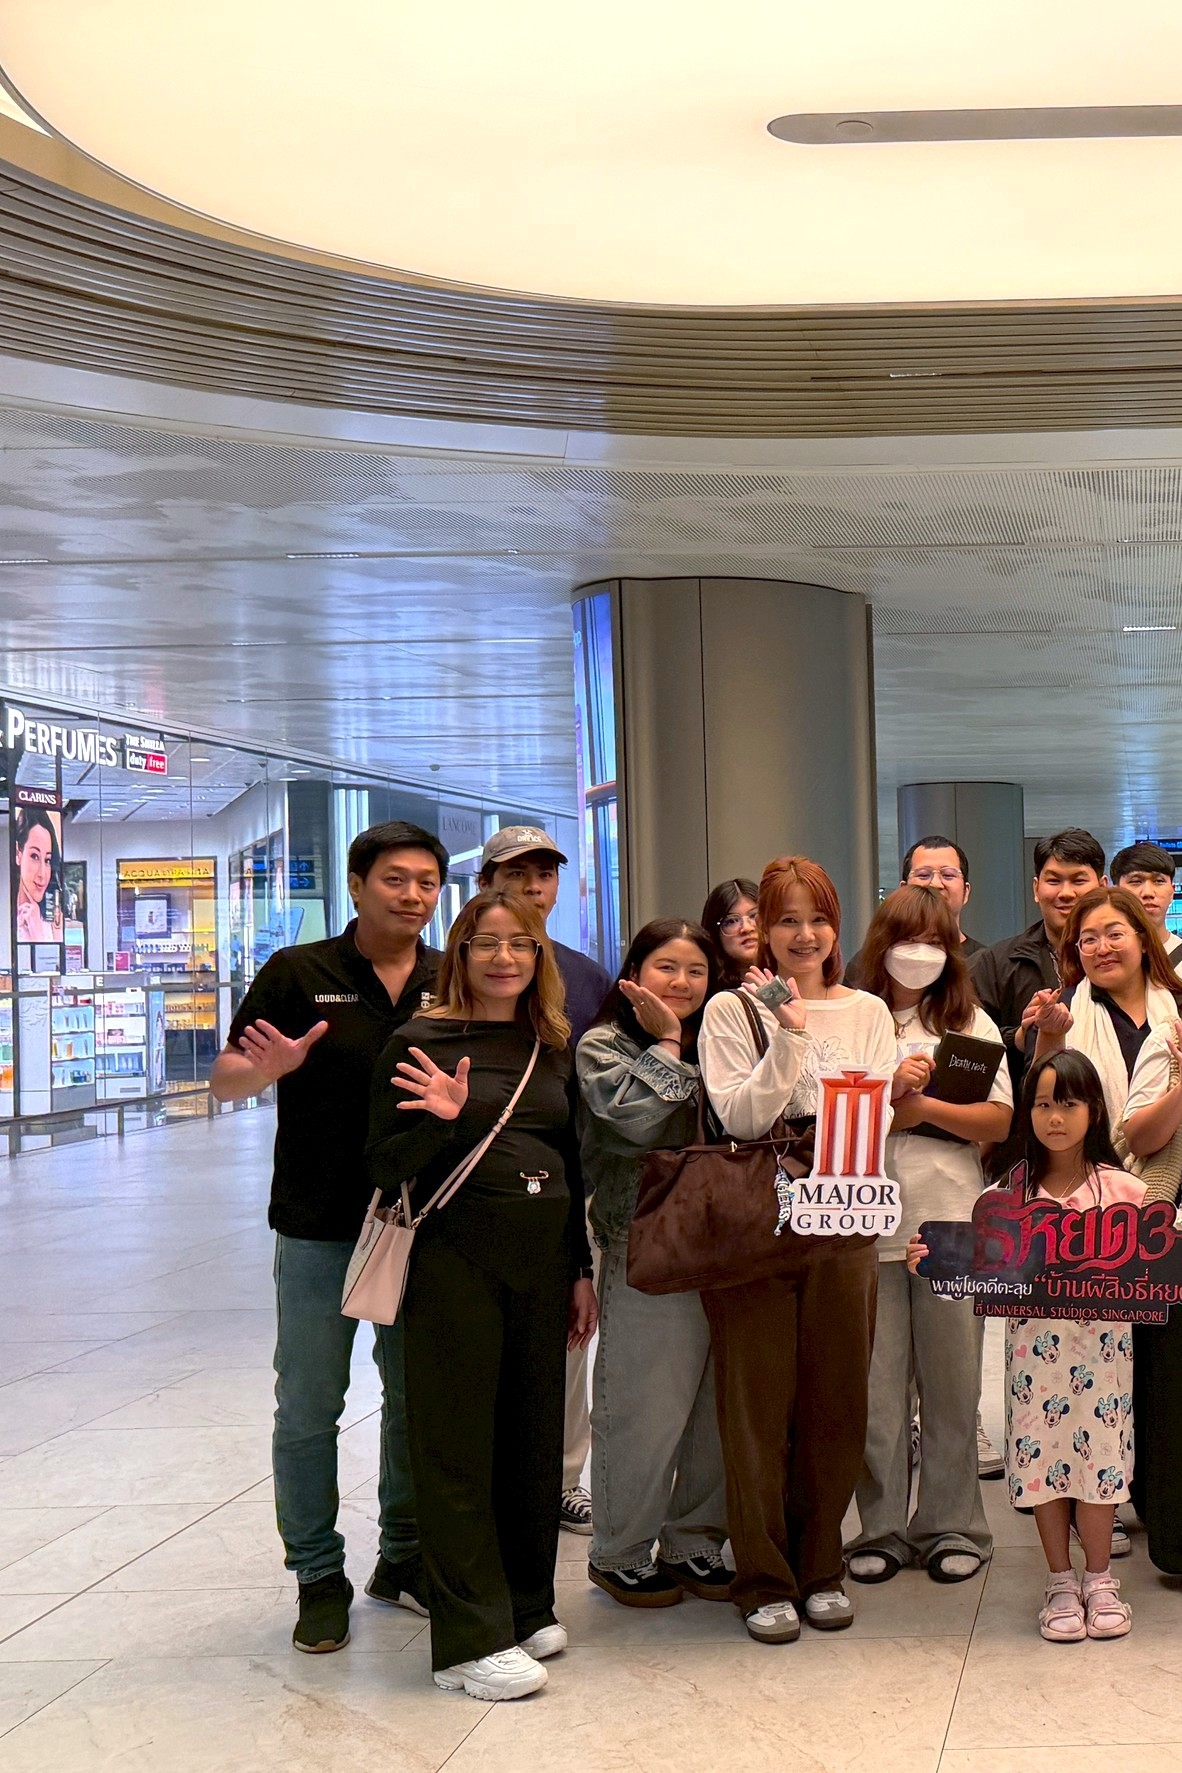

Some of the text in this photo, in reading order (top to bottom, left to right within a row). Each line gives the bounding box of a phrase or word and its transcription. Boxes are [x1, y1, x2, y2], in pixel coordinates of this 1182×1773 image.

[8, 708, 117, 767] PERFUMES
[130, 753, 165, 770] duty free
[18, 790, 57, 805] CLARINS
[124, 869, 161, 878] ACQUA
[315, 994, 359, 1003] LOUD&CLEAR
[798, 1183, 896, 1210] MAJOR
[797, 1214, 896, 1230] GROUP
[931, 1274, 1033, 1299] พาผู้โชคดีตะลุย
[986, 1304, 1046, 1318] UNIVERSAL
[1050, 1306, 1098, 1320] STUDIOS
[1102, 1308, 1165, 1322] SINGAPORE
